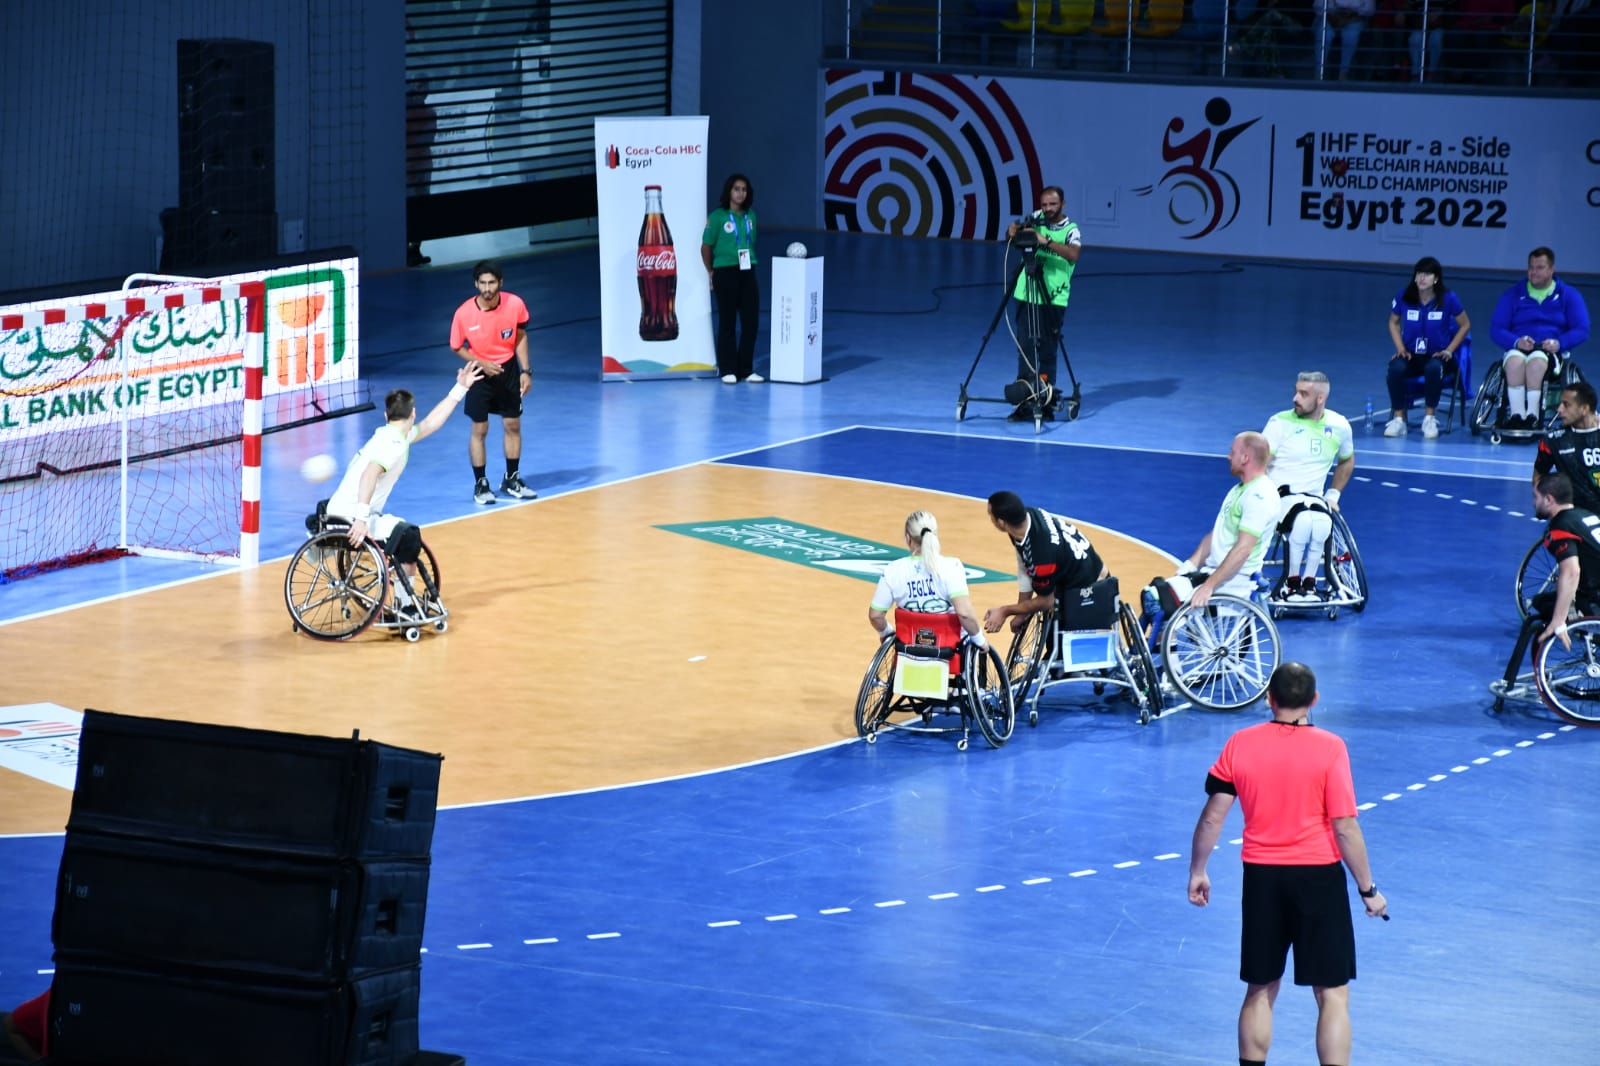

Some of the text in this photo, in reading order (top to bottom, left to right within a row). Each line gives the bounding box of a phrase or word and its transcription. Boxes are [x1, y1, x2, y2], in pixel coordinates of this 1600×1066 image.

[625, 145, 702, 156] Coca-Cola HBC
[1321, 132, 1358, 152] IHF
[1363, 133, 1411, 155] Four
[1462, 136, 1510, 158] Side
[625, 158, 652, 169] Egypt
[1424, 159, 1509, 176] HANDBALL
[1321, 173, 1508, 195] WORLD CHAMPIONSHIP
[1301, 191, 1507, 231] Egypt 2022
[638, 250, 676, 270] Coca-Cola
[29, 386, 106, 423] BANK
[113, 380, 151, 408] OF
[159, 365, 242, 401] EGYPT
[1310, 438, 1321, 456] 5
